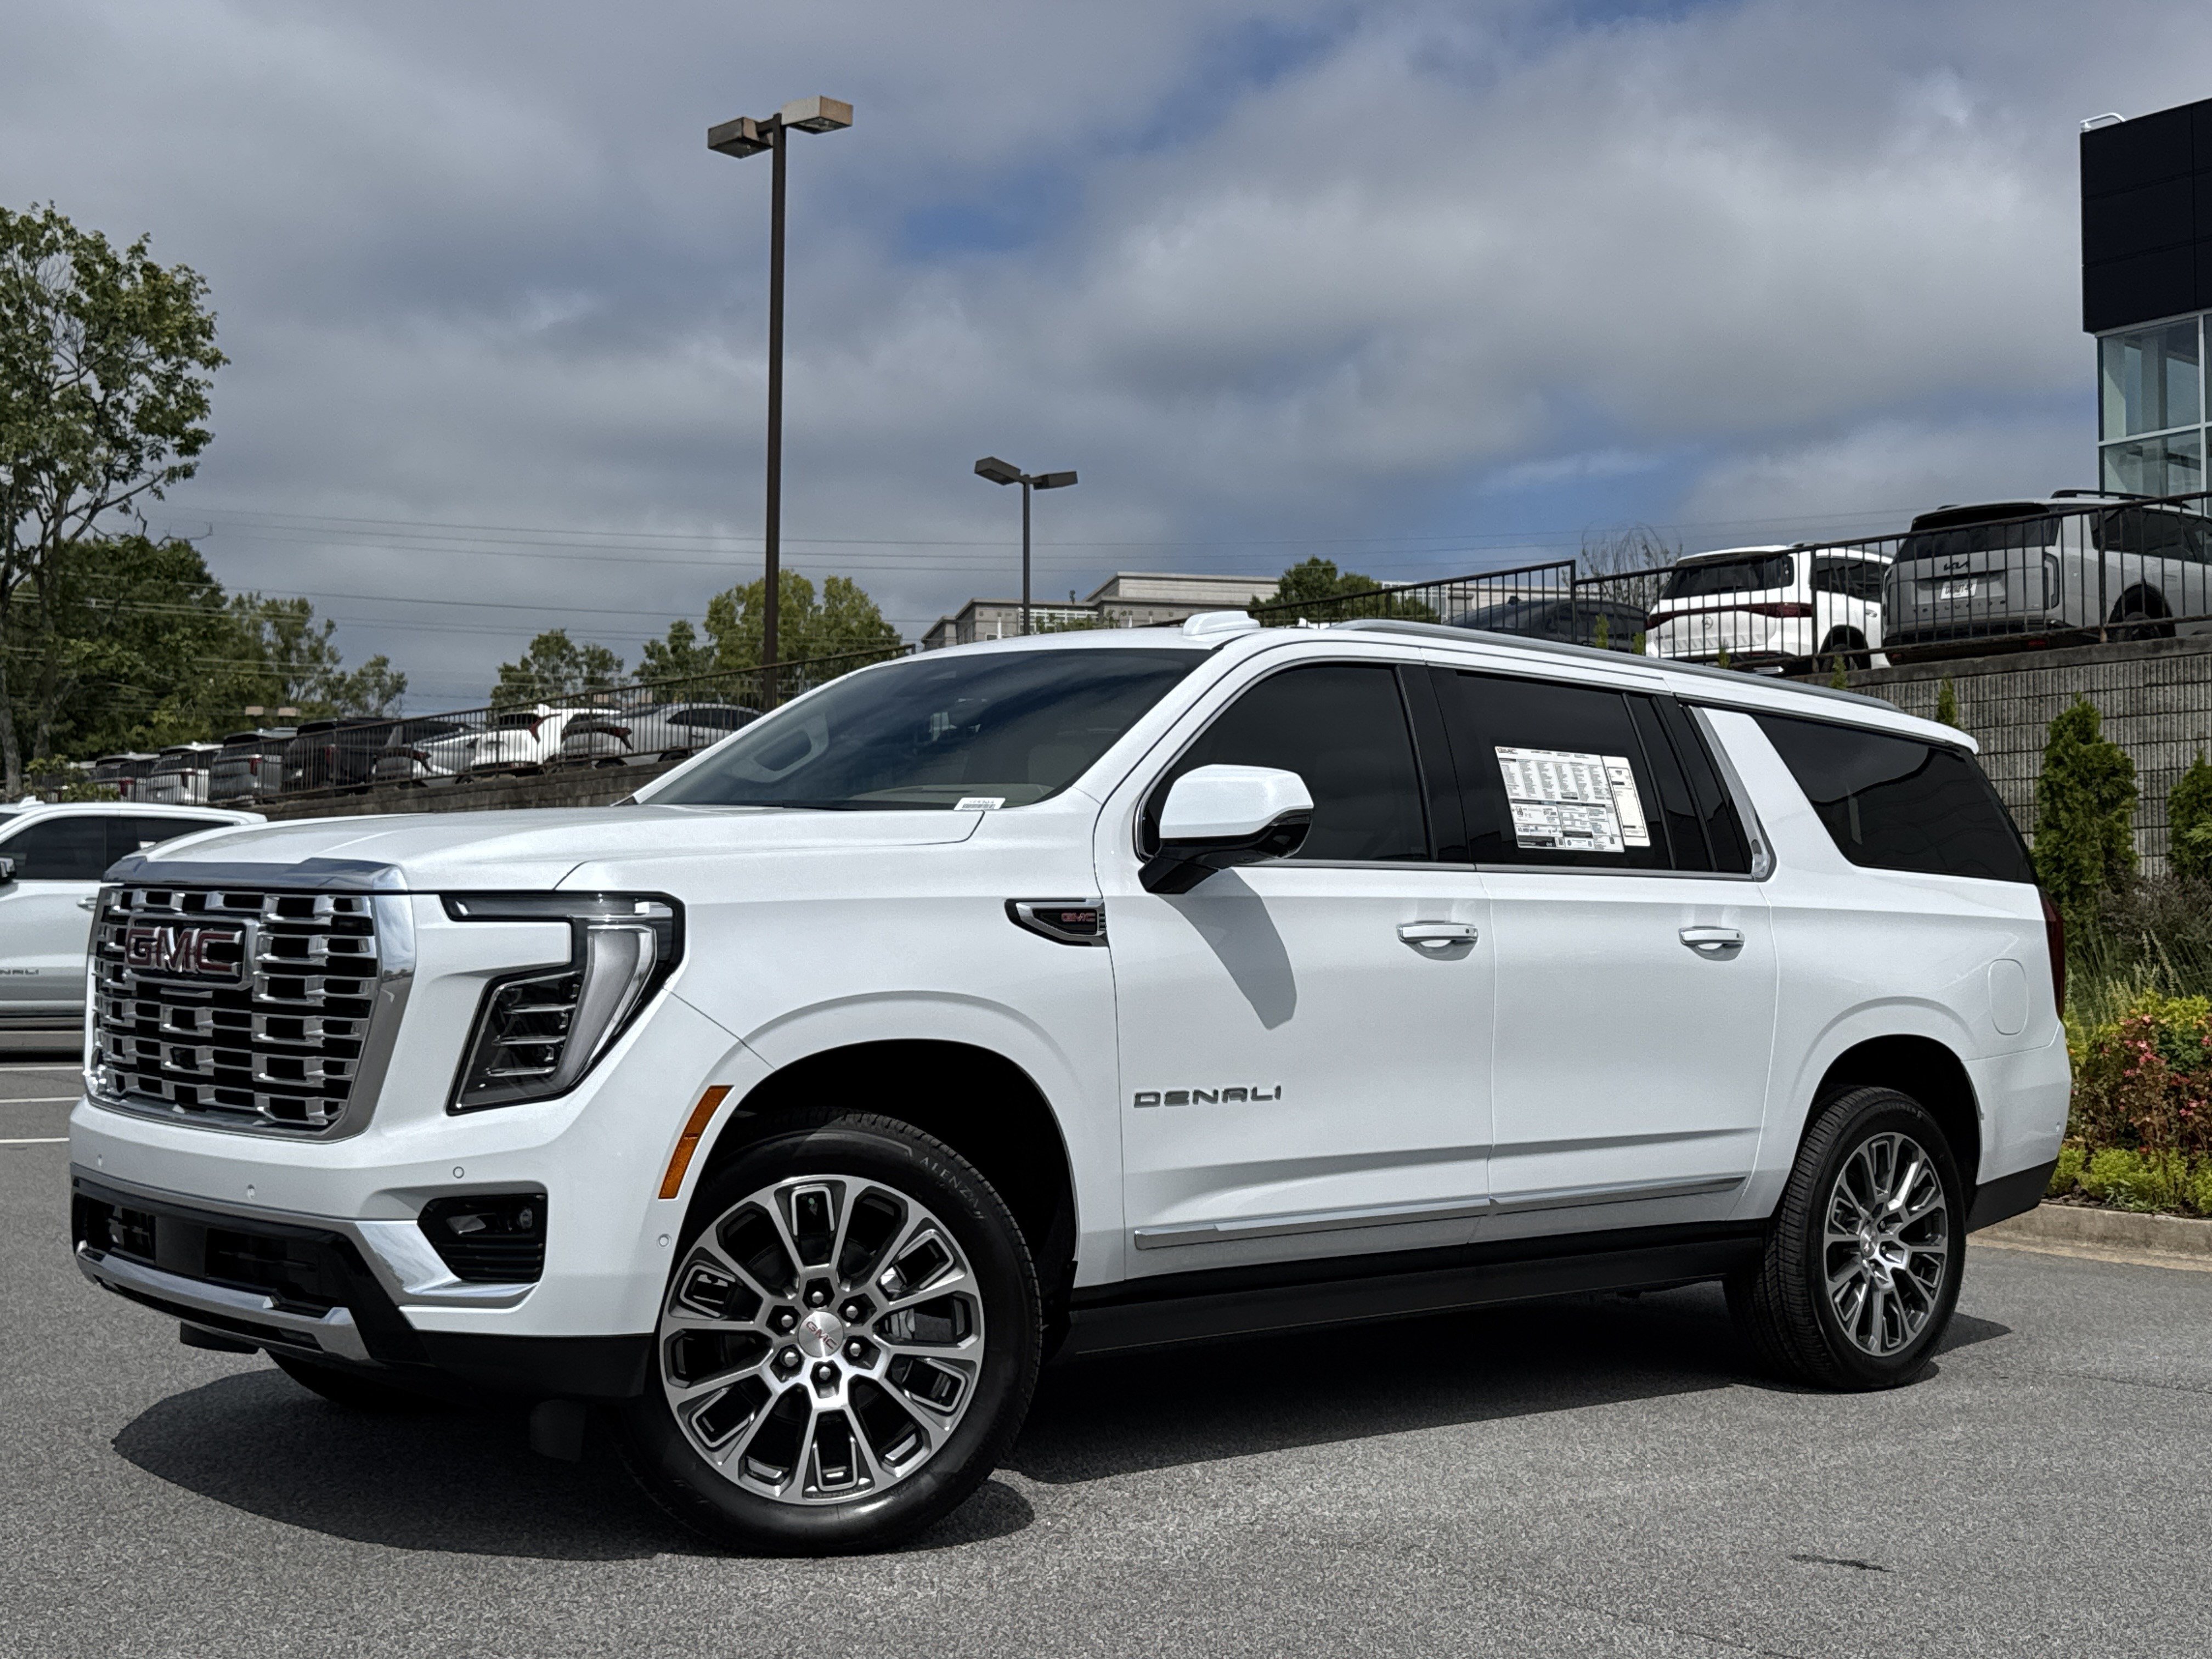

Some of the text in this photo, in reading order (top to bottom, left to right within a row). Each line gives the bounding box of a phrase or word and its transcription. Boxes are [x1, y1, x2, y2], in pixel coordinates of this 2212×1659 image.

[1062, 912, 1096, 922] GMC
[126, 926, 243, 976] GMC
[1134, 1085, 1282, 1108] DENALI
[919, 1156, 979, 1208] ALENZA
[806, 1321, 837, 1350] GMC
